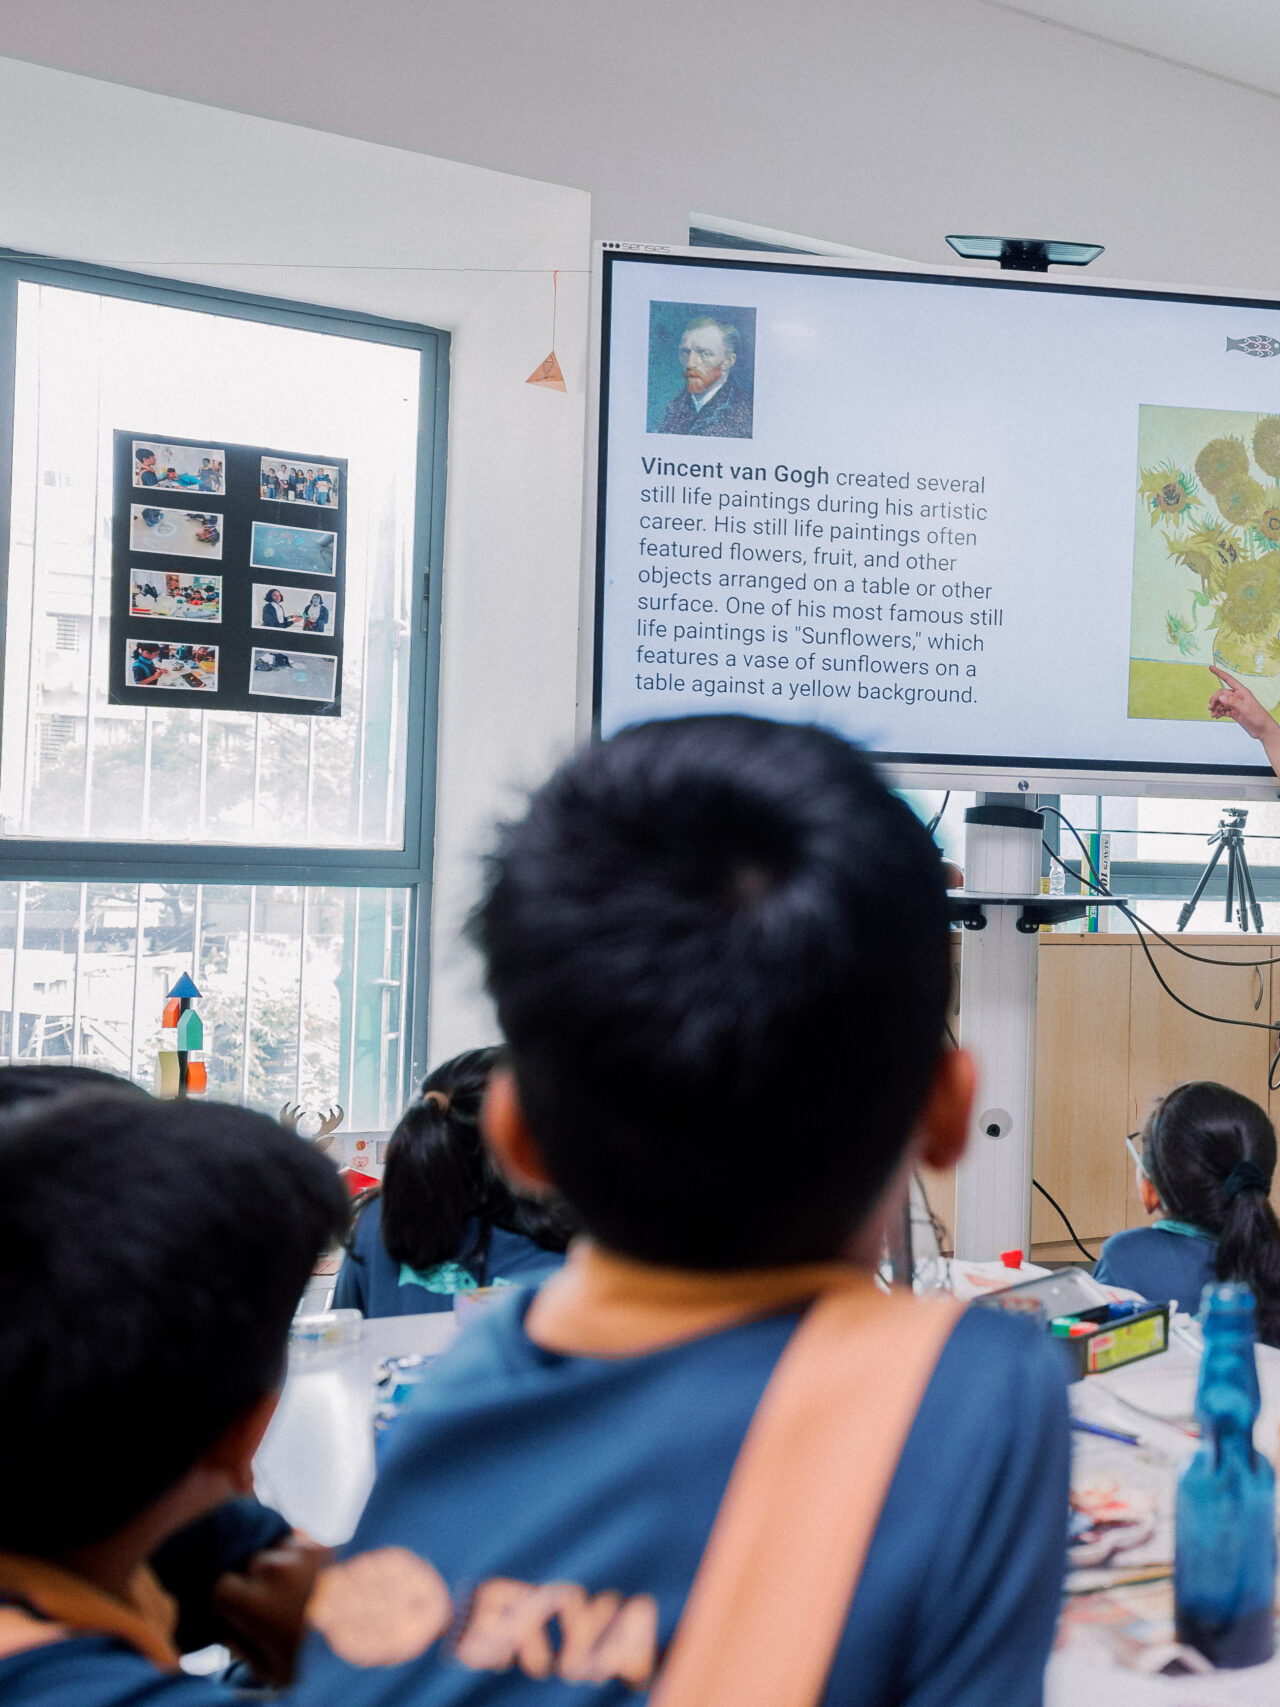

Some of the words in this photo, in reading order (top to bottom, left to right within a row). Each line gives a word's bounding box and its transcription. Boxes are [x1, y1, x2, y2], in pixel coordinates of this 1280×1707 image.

[641, 457, 723, 479] Vincent
[729, 466, 766, 481] van
[774, 465, 829, 488] Gogh
[836, 472, 909, 489] created
[917, 476, 984, 493] several
[640, 485, 675, 503] still
[683, 486, 712, 505] life
[719, 490, 810, 515] paintings
[817, 494, 878, 519] during
[886, 498, 913, 516] his
[920, 501, 987, 520] artistic
[640, 516, 706, 531] career.
[715, 515, 746, 535] His
[752, 518, 787, 536] still
[795, 519, 825, 539] life
[830, 522, 920, 548] paintings
[927, 527, 976, 546] often
[638, 537, 722, 559] featured
[729, 542, 806, 566] flowers,
[813, 546, 857, 569] fruit,
[864, 551, 900, 568] and
[905, 553, 957, 571] other
[638, 565, 712, 588] objects
[719, 572, 808, 594] arranged
[814, 576, 837, 592] on
[844, 579, 855, 593] a
[861, 576, 911, 596] table
[916, 583, 936, 597] or
[942, 581, 992, 599] other
[637, 593, 719, 613] surface.
[726, 596, 765, 616] One
[771, 598, 792, 616] of
[797, 598, 827, 618] his
[832, 604, 884, 622] most
[888, 602, 964, 624] famous
[968, 609, 1004, 626] still
[637, 618, 668, 638] life
[673, 621, 765, 646] paintings
[771, 625, 788, 643] is
[794, 626, 922, 651] "Sunflowers,"
[927, 632, 984, 651] which
[636, 644, 720, 666] features
[724, 654, 737, 668] a
[742, 654, 789, 670] vase
[795, 653, 816, 672] of
[820, 654, 930, 676] sunflowers
[935, 663, 960, 677] on
[965, 664, 977, 677] a
[635, 672, 685, 691] table
[690, 676, 765, 697] against
[772, 682, 783, 695] a
[789, 679, 851, 700] yellow
[858, 681, 977, 705] background.
